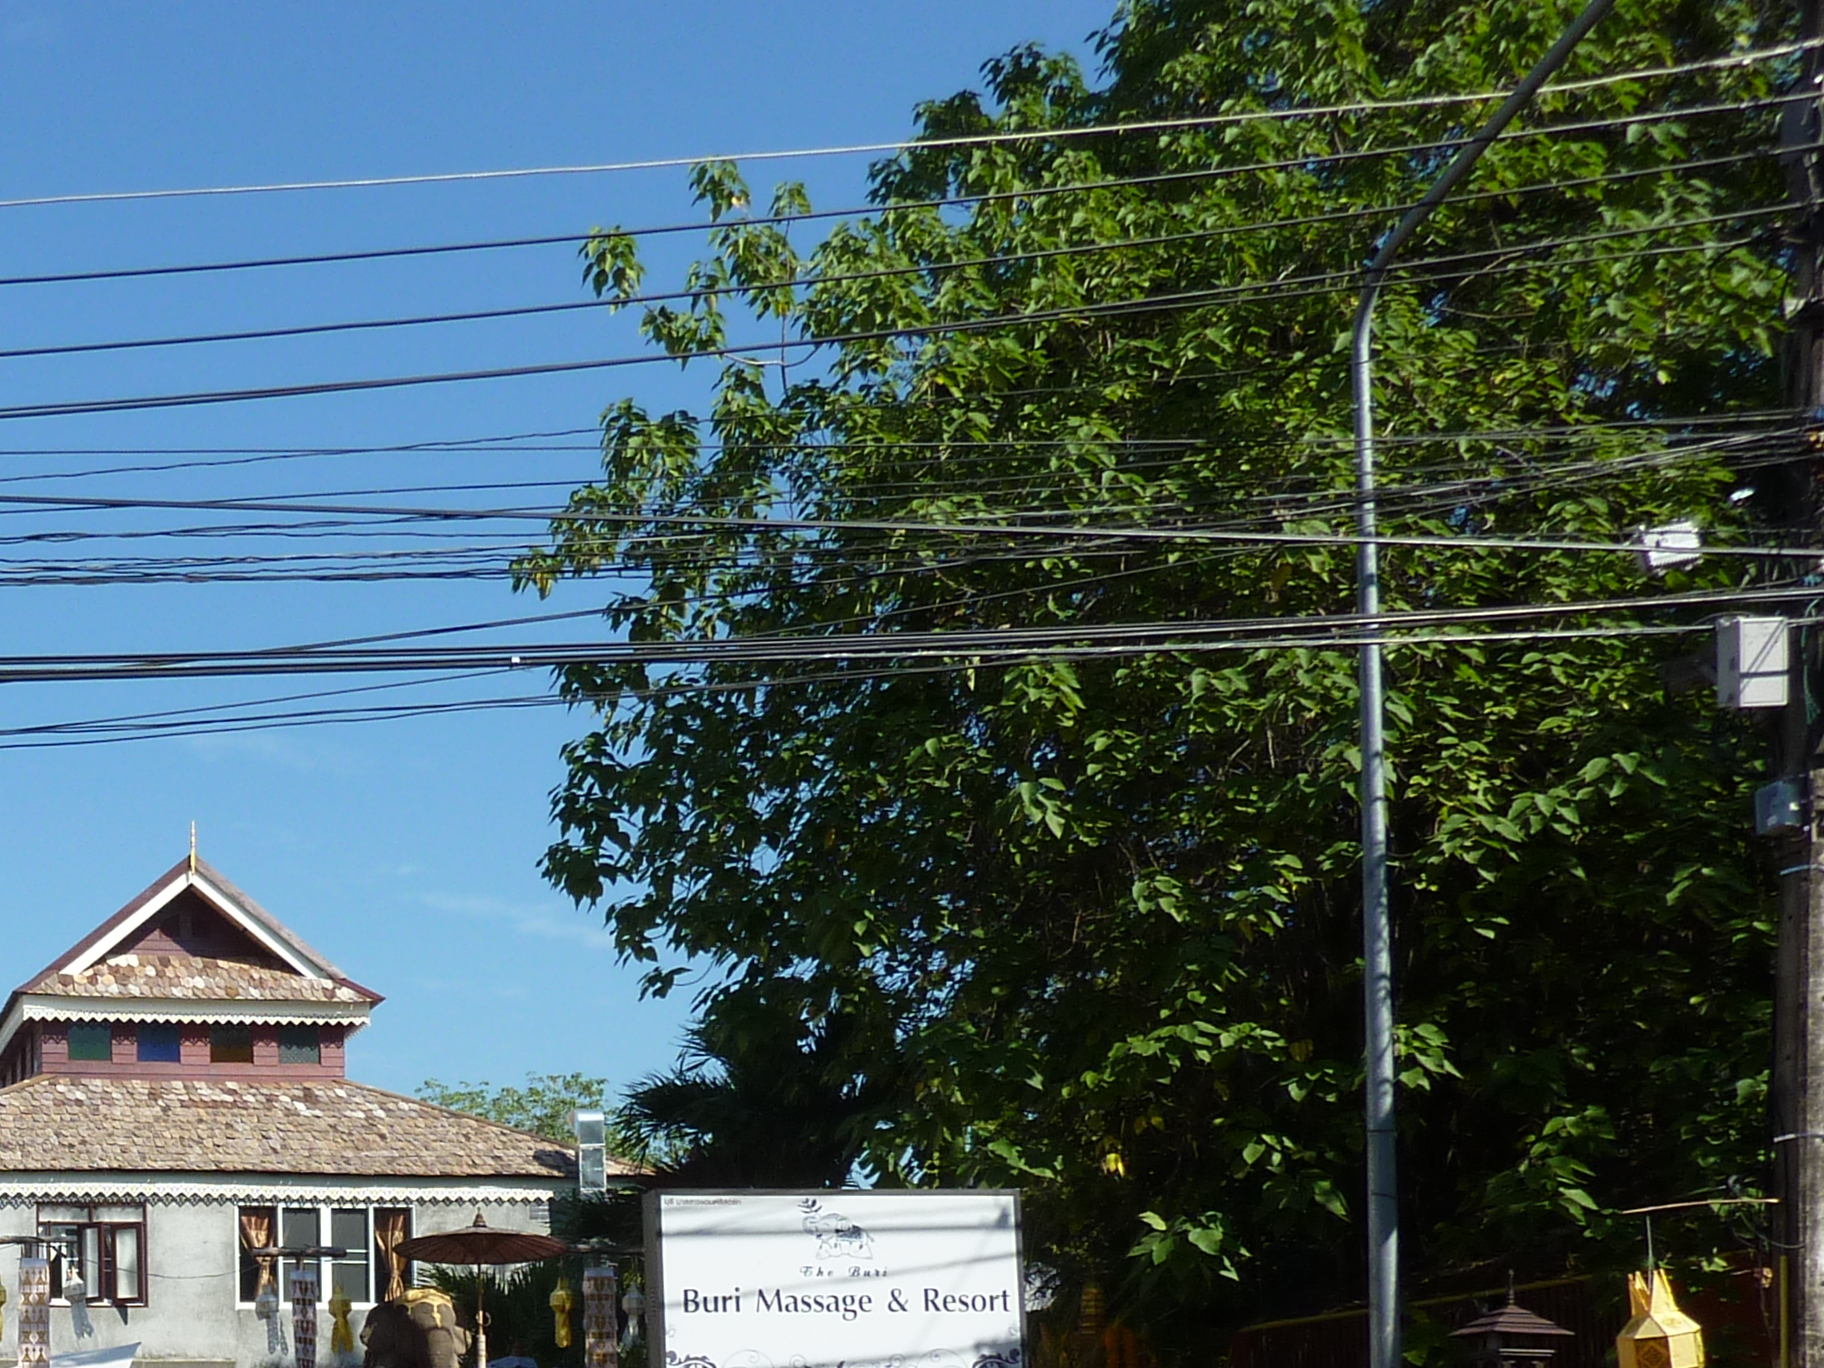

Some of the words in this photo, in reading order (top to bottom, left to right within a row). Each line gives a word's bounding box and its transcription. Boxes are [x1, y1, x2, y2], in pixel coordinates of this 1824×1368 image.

[799, 1265, 834, 1277] The
[848, 1265, 888, 1278] Buri
[682, 1287, 742, 1314] Buri
[756, 1287, 873, 1321] Massage
[887, 1287, 909, 1313] &
[923, 1287, 1011, 1313] Resort
